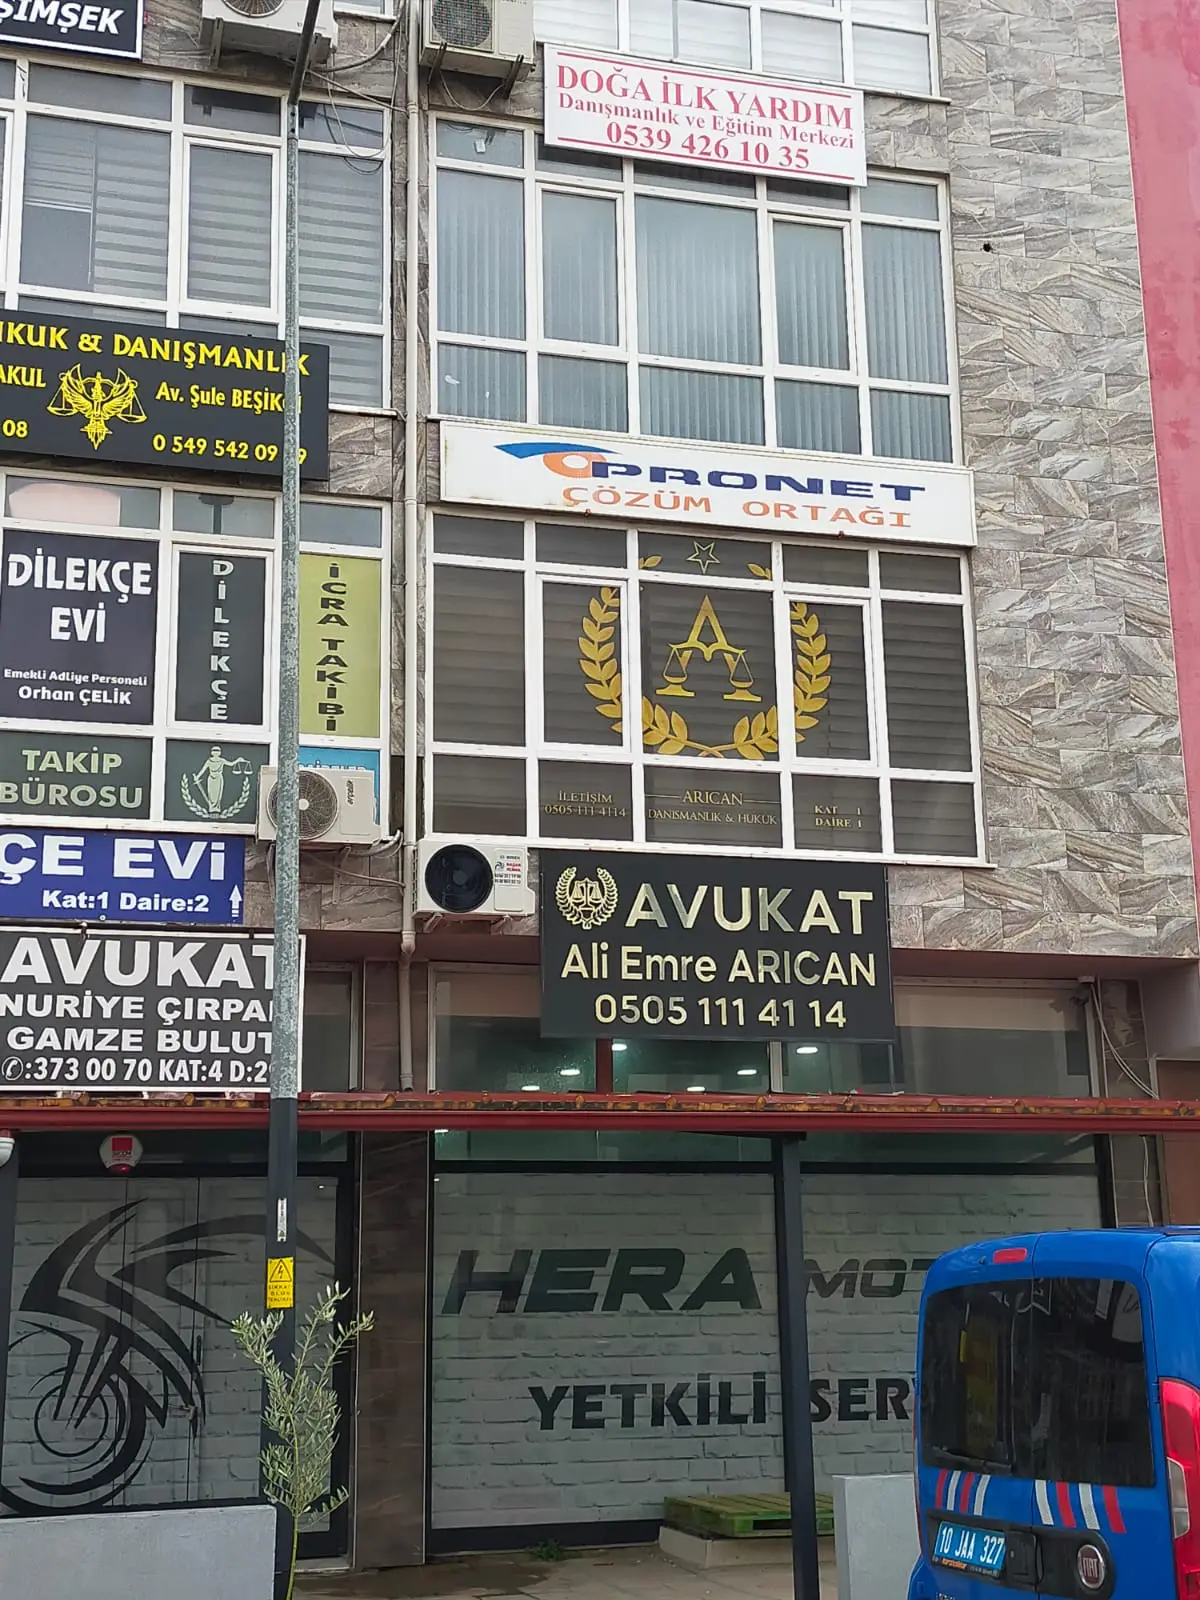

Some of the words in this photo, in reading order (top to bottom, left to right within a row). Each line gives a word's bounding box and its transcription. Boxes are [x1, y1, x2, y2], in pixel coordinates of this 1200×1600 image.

[557, 65, 653, 103] DOĞA
[660, 75, 719, 112] İLK
[726, 90, 854, 130] YARDIM
[559, 93, 680, 126] Danışmanlık
[686, 116, 705, 128] ve
[712, 115, 772, 137] Eğitim
[780, 124, 854, 149] Merkezi
[607, 121, 672, 150] 0539
[681, 133, 729, 159] 426
[740, 141, 769, 164] 10
[778, 146, 809, 169] 35
[0, 320, 69, 350] KUK
[78, 333, 102, 353] &
[156, 381, 185, 402] Av.
[190, 384, 226, 408] Şule
[2, 419, 28, 438] 08
[153, 434, 166, 451] 0
[171, 436, 207, 455] 549
[214, 439, 249, 459] 542
[255, 444, 278, 462] 09
[592, 461, 926, 501] PRONET
[563, 485, 711, 512] ÇÖZÜM
[743, 501, 911, 528] ORTAĞI
[7, 548, 152, 603] DİLEKÇE
[51, 602, 106, 642] EVİ
[4, 668, 47, 680] Emekli
[49, 671, 89, 684] Adliye
[91, 674, 147, 686] Personeli
[18, 685, 75, 701] Orhan
[79, 688, 131, 706] ÇELİK
[22, 746, 122, 774] TAKİP
[0, 777, 142, 808] BÜROSU
[682, 789, 743, 806] ARICAN
[42, 890, 108, 909] Kat:1
[120, 892, 209, 912] Daire:2
[625, 883, 873, 935] AVUKAT
[0, 937, 274, 990] AVUKAT
[561, 942, 609, 978] Ali
[621, 945, 717, 982] Emre
[728, 949, 876, 986] ARICAN
[0, 990, 144, 1019] NURİYE
[157, 996, 273, 1026] ÇIRPA
[595, 994, 688, 1025] 0505
[698, 997, 745, 1026] 111
[758, 999, 795, 1027] 41
[808, 1000, 847, 1028] 14
[7, 1026, 143, 1052] GAMZE
[86, 1058, 116, 1081] 00
[123, 1058, 152, 1082] 70
[158, 1059, 222, 1082] KAT:4
[229, 1060, 271, 1083] D:2
[441, 1247, 762, 1315] HERA
[528, 1372, 767, 1430] YETKİLİ
[810, 1378, 917, 1423] SER
[940, 1527, 954, 1554] 10
[954, 1530, 976, 1560] JAA
[980, 1535, 1005, 1565] 327
